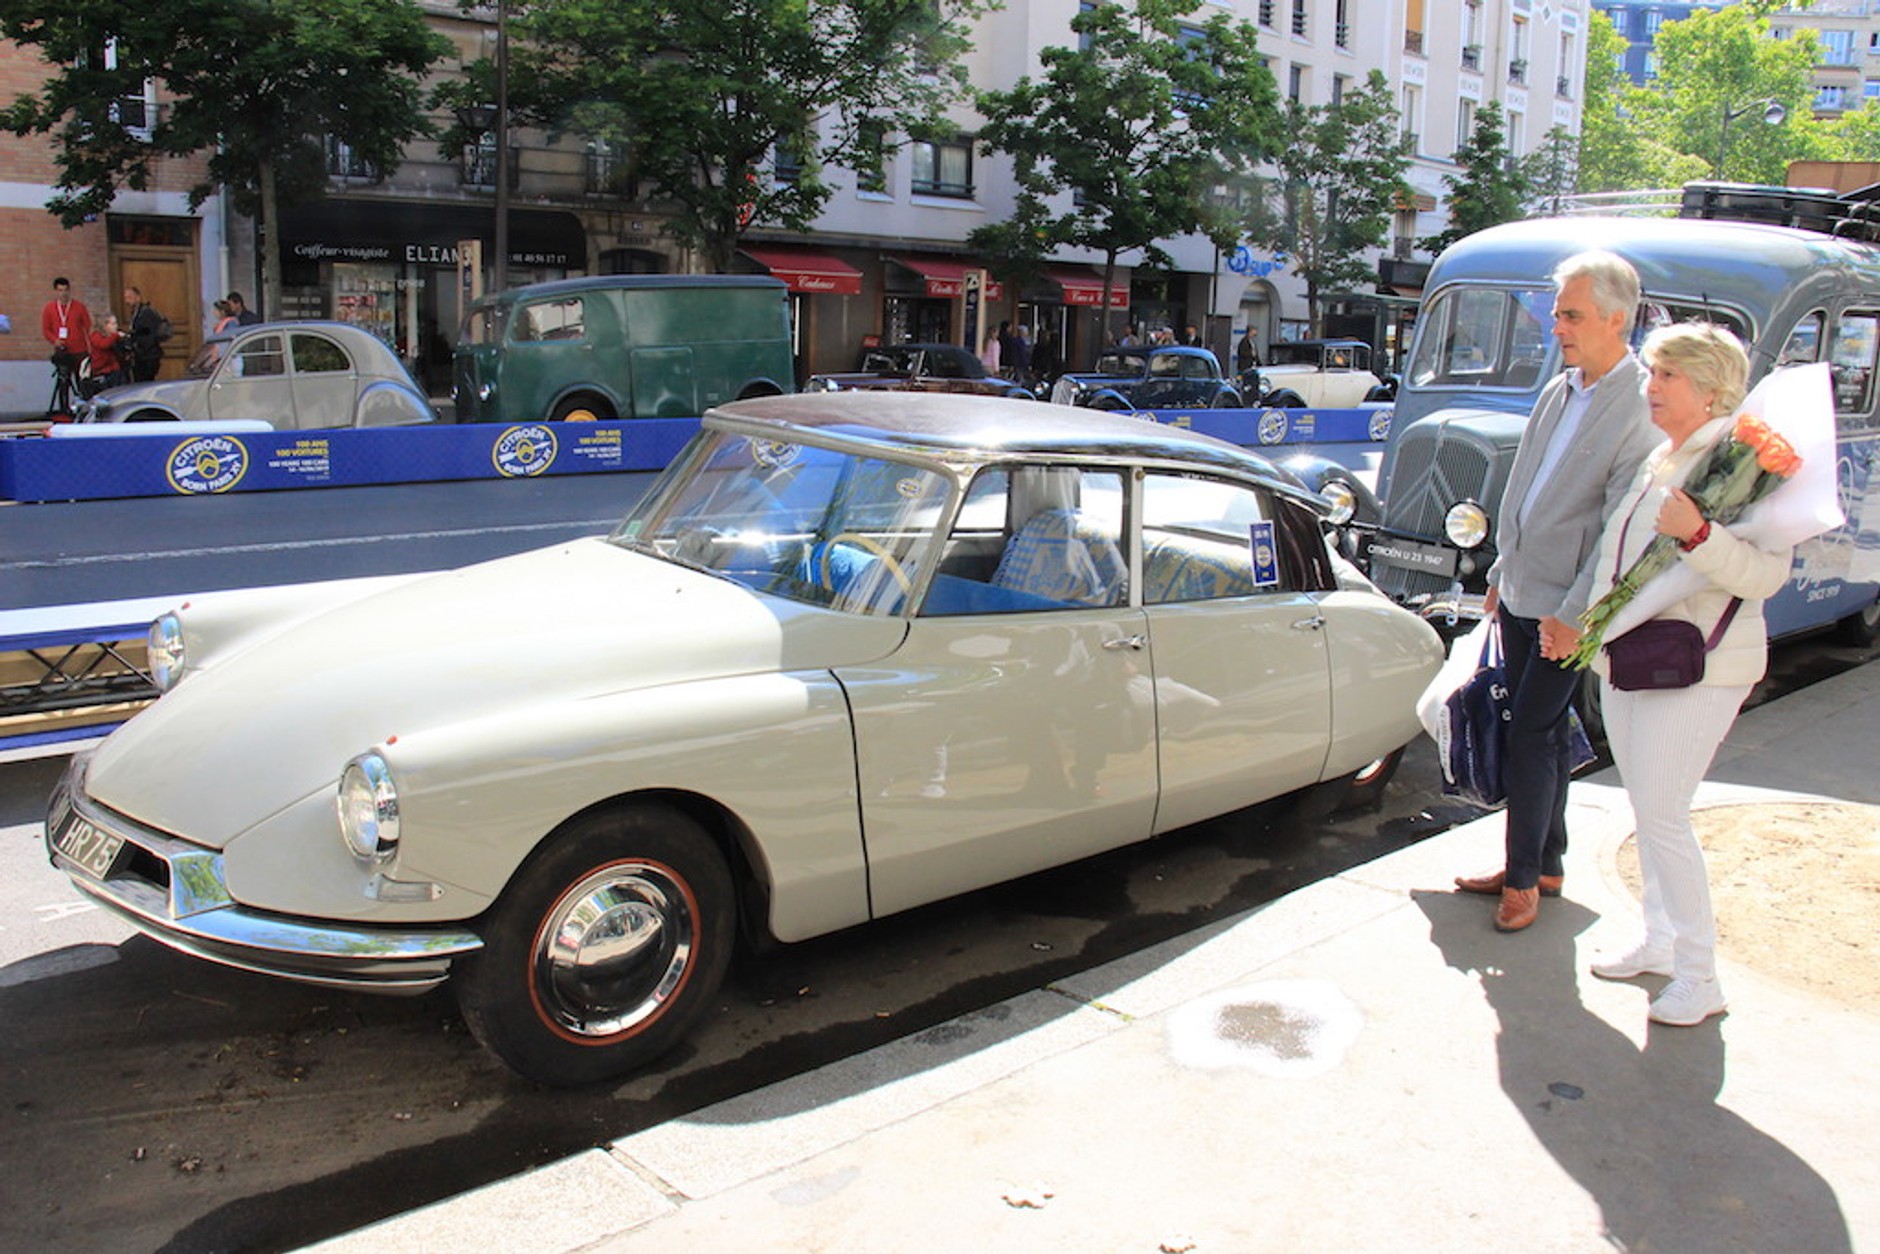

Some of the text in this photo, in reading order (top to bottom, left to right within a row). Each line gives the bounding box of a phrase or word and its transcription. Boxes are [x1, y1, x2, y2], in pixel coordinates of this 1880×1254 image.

[294, 243, 389, 260] Coiffeur-visagiste
[175, 437, 233, 467] CITROËN
[499, 427, 546, 453] CITROËN
[1367, 544, 1444, 565] CITROËN U 23 1947
[59, 817, 119, 871] HR 75
